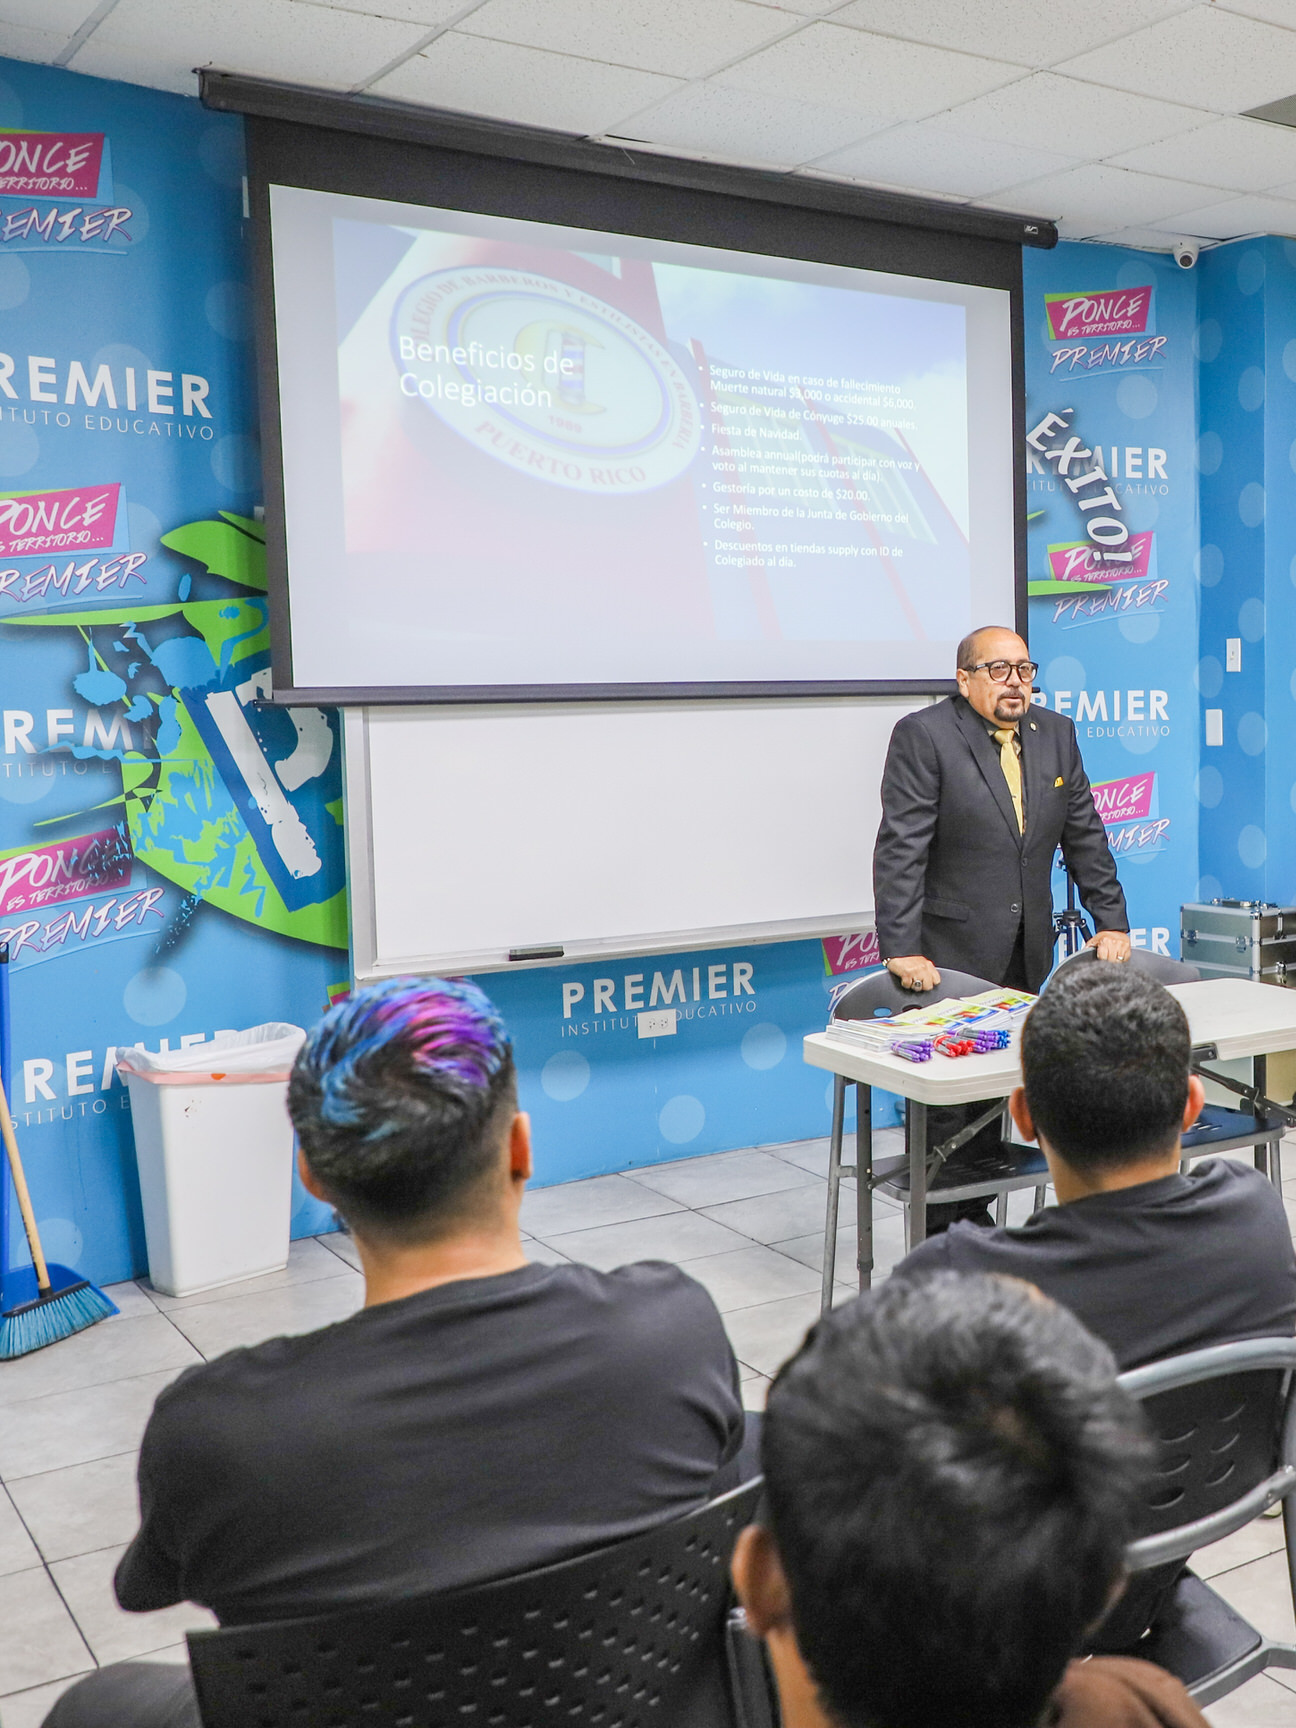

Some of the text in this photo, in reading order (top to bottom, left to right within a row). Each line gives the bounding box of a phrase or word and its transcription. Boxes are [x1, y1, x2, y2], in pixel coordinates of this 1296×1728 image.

[0, 141, 94, 174] ONCE
[0, 176, 88, 191] ERRITORIO...
[0, 207, 133, 242] EMIER
[1062, 292, 1145, 332] PONCE
[400, 336, 574, 376] Beneficios de
[1050, 335, 1168, 374] PREMIER
[400, 372, 552, 407] Colegiación
[709, 364, 901, 395] Seguro de Vida en caso de fallecimiento
[710, 380, 749, 394] Muerte
[751, 385, 787, 397] natural
[824, 393, 831, 401] o
[833, 393, 881, 407] accidental
[0, 406, 214, 441] ITUTO EDUCATIVO
[710, 401, 918, 432] Seguro de Vida de Cónyuge $25.00 anuales.
[711, 423, 802, 441] Fiesta de Navidad.
[474, 420, 646, 485] PUERTO RICO
[711, 445, 762, 459] Asamblea
[831, 455, 876, 468] participar
[879, 459, 895, 469] con
[897, 461, 912, 470] voz
[712, 461, 736, 472] voto
[738, 461, 748, 473] al
[750, 464, 798, 476] mantener
[800, 466, 816, 478] sus
[818, 469, 850, 480] cuotas
[851, 470, 860, 481] al
[1026, 407, 1133, 562] ÉXITO!
[712, 481, 871, 502] Gestoría por un costo de $20.00.
[713, 503, 909, 524] Ser Miembro de la Junta de Gobierno del
[714, 518, 755, 533] Colegio.
[714, 539, 904, 558] Descuentos en tiendas supply con ID de
[715, 553, 765, 569] Colegiado
[767, 556, 777, 567] al
[0, 552, 147, 602] REMIER
[1052, 579, 1169, 623] PREMIER
[1031, 690, 1169, 722] EMIER
[1088, 725, 1170, 738] EDUCATIVO
[2, 760, 89, 779] TITUTO
[1093, 779, 1148, 812] ONCE
[1107, 818, 1171, 852] MIER
[6, 894, 26, 912] ES
[562, 962, 756, 1019] PREMIER
[676, 1001, 757, 1022] DUCATIVO
[10, 1098, 106, 1130] STITUTO
